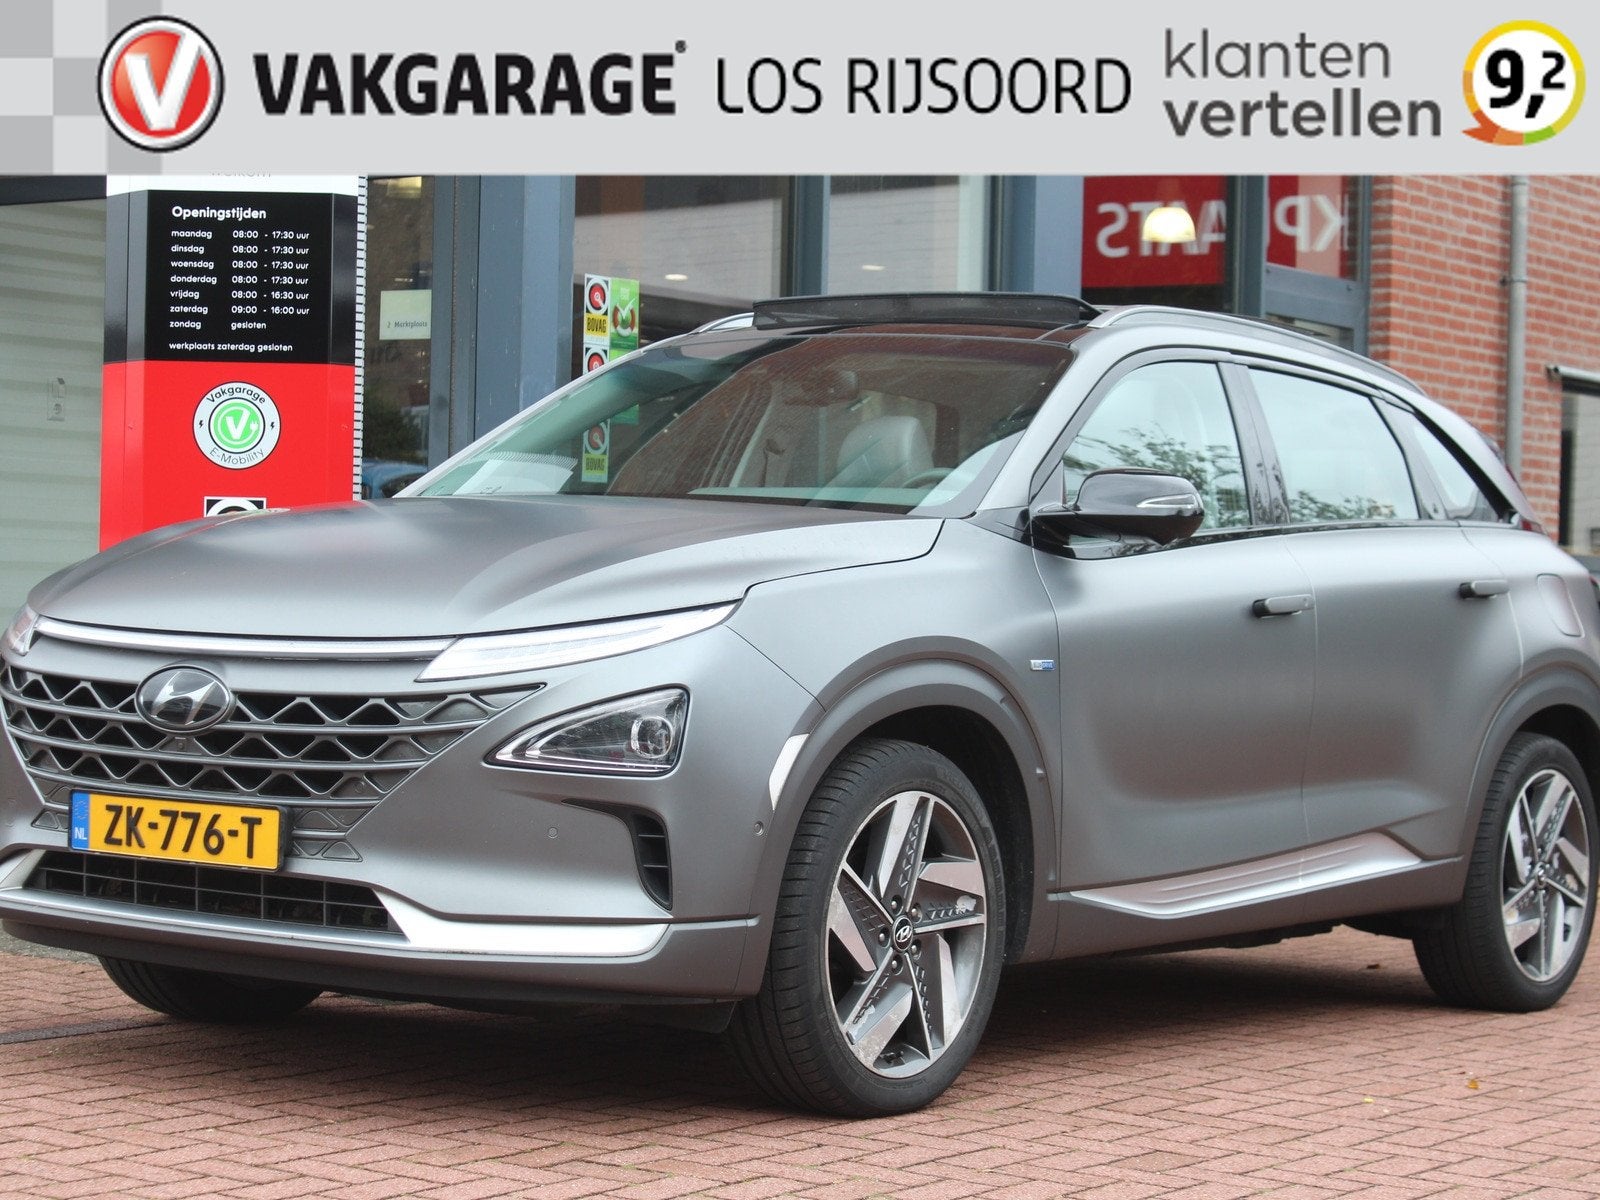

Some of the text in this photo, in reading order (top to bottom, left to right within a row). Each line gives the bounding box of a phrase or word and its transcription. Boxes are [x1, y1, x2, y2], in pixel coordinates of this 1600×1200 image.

[171, 205, 267, 222] Openingstijden
[171, 230, 213, 240] maandag
[232, 230, 259, 239] 08:00
[271, 231, 295, 240] 17:30
[171, 245, 205, 254] dinsdag
[232, 245, 259, 254] 08:00
[271, 246, 294, 255] 17:30
[170, 260, 215, 270] woensdag
[232, 260, 258, 269] 08:00
[271, 261, 294, 270] 17:30
[170, 275, 218, 285] donderdag
[231, 276, 258, 284] 08:00
[271, 276, 294, 285] 17:30
[170, 290, 200, 300] vrijdag
[231, 291, 258, 299] 08:00
[270, 291, 294, 300] 16:30
[170, 305, 209, 315] zaterdag
[231, 306, 258, 314] 09:00
[270, 306, 295, 315] 16:00
[169, 320, 267, 331] zondag gesloten
[586, 317, 607, 333] BOVAG
[169, 341, 293, 353] werkplaats zaterdag gesloten
[206, 386, 266, 404] Vakgarage
[209, 447, 265, 465] E-Mobility
[74, 826, 87, 841] NL
[103, 803, 263, 860] ZK-776-T
